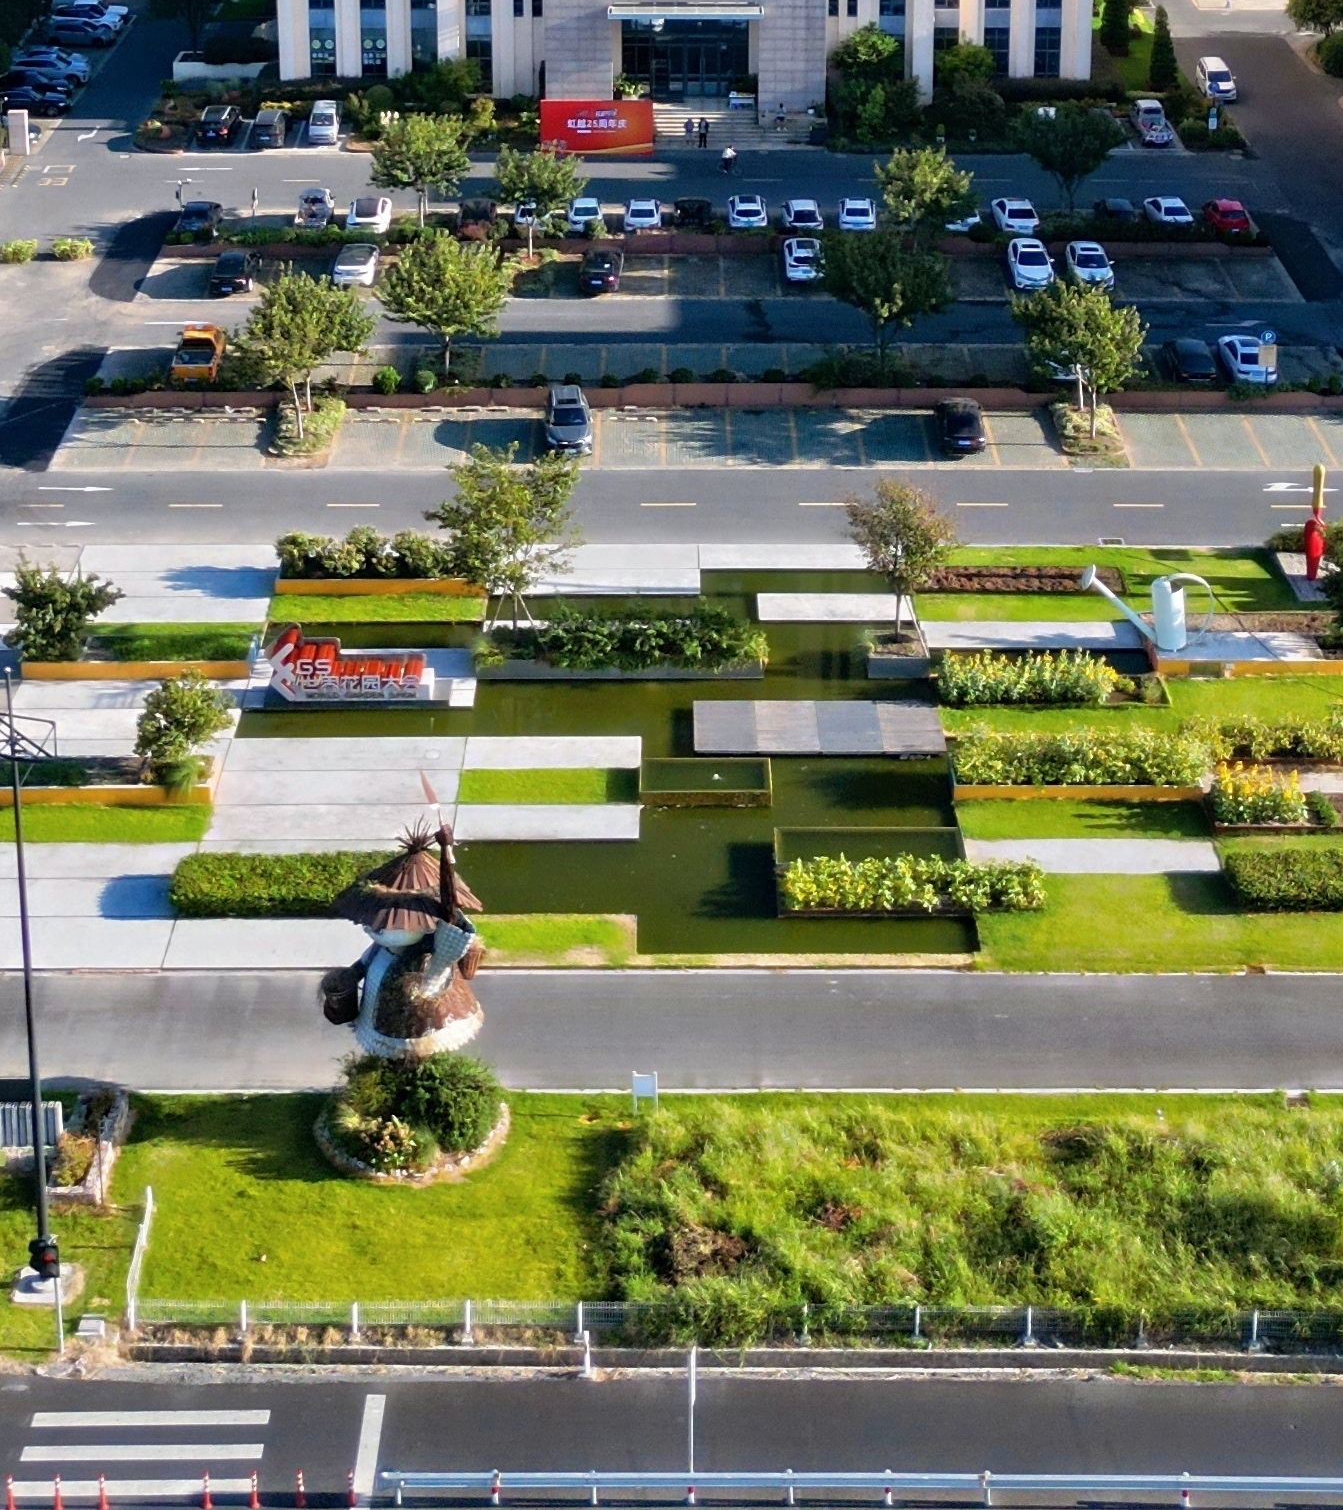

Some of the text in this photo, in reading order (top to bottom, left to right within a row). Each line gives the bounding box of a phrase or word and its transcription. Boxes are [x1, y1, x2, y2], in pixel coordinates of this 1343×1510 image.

[296, 674, 421, 692] 世界花园大会
